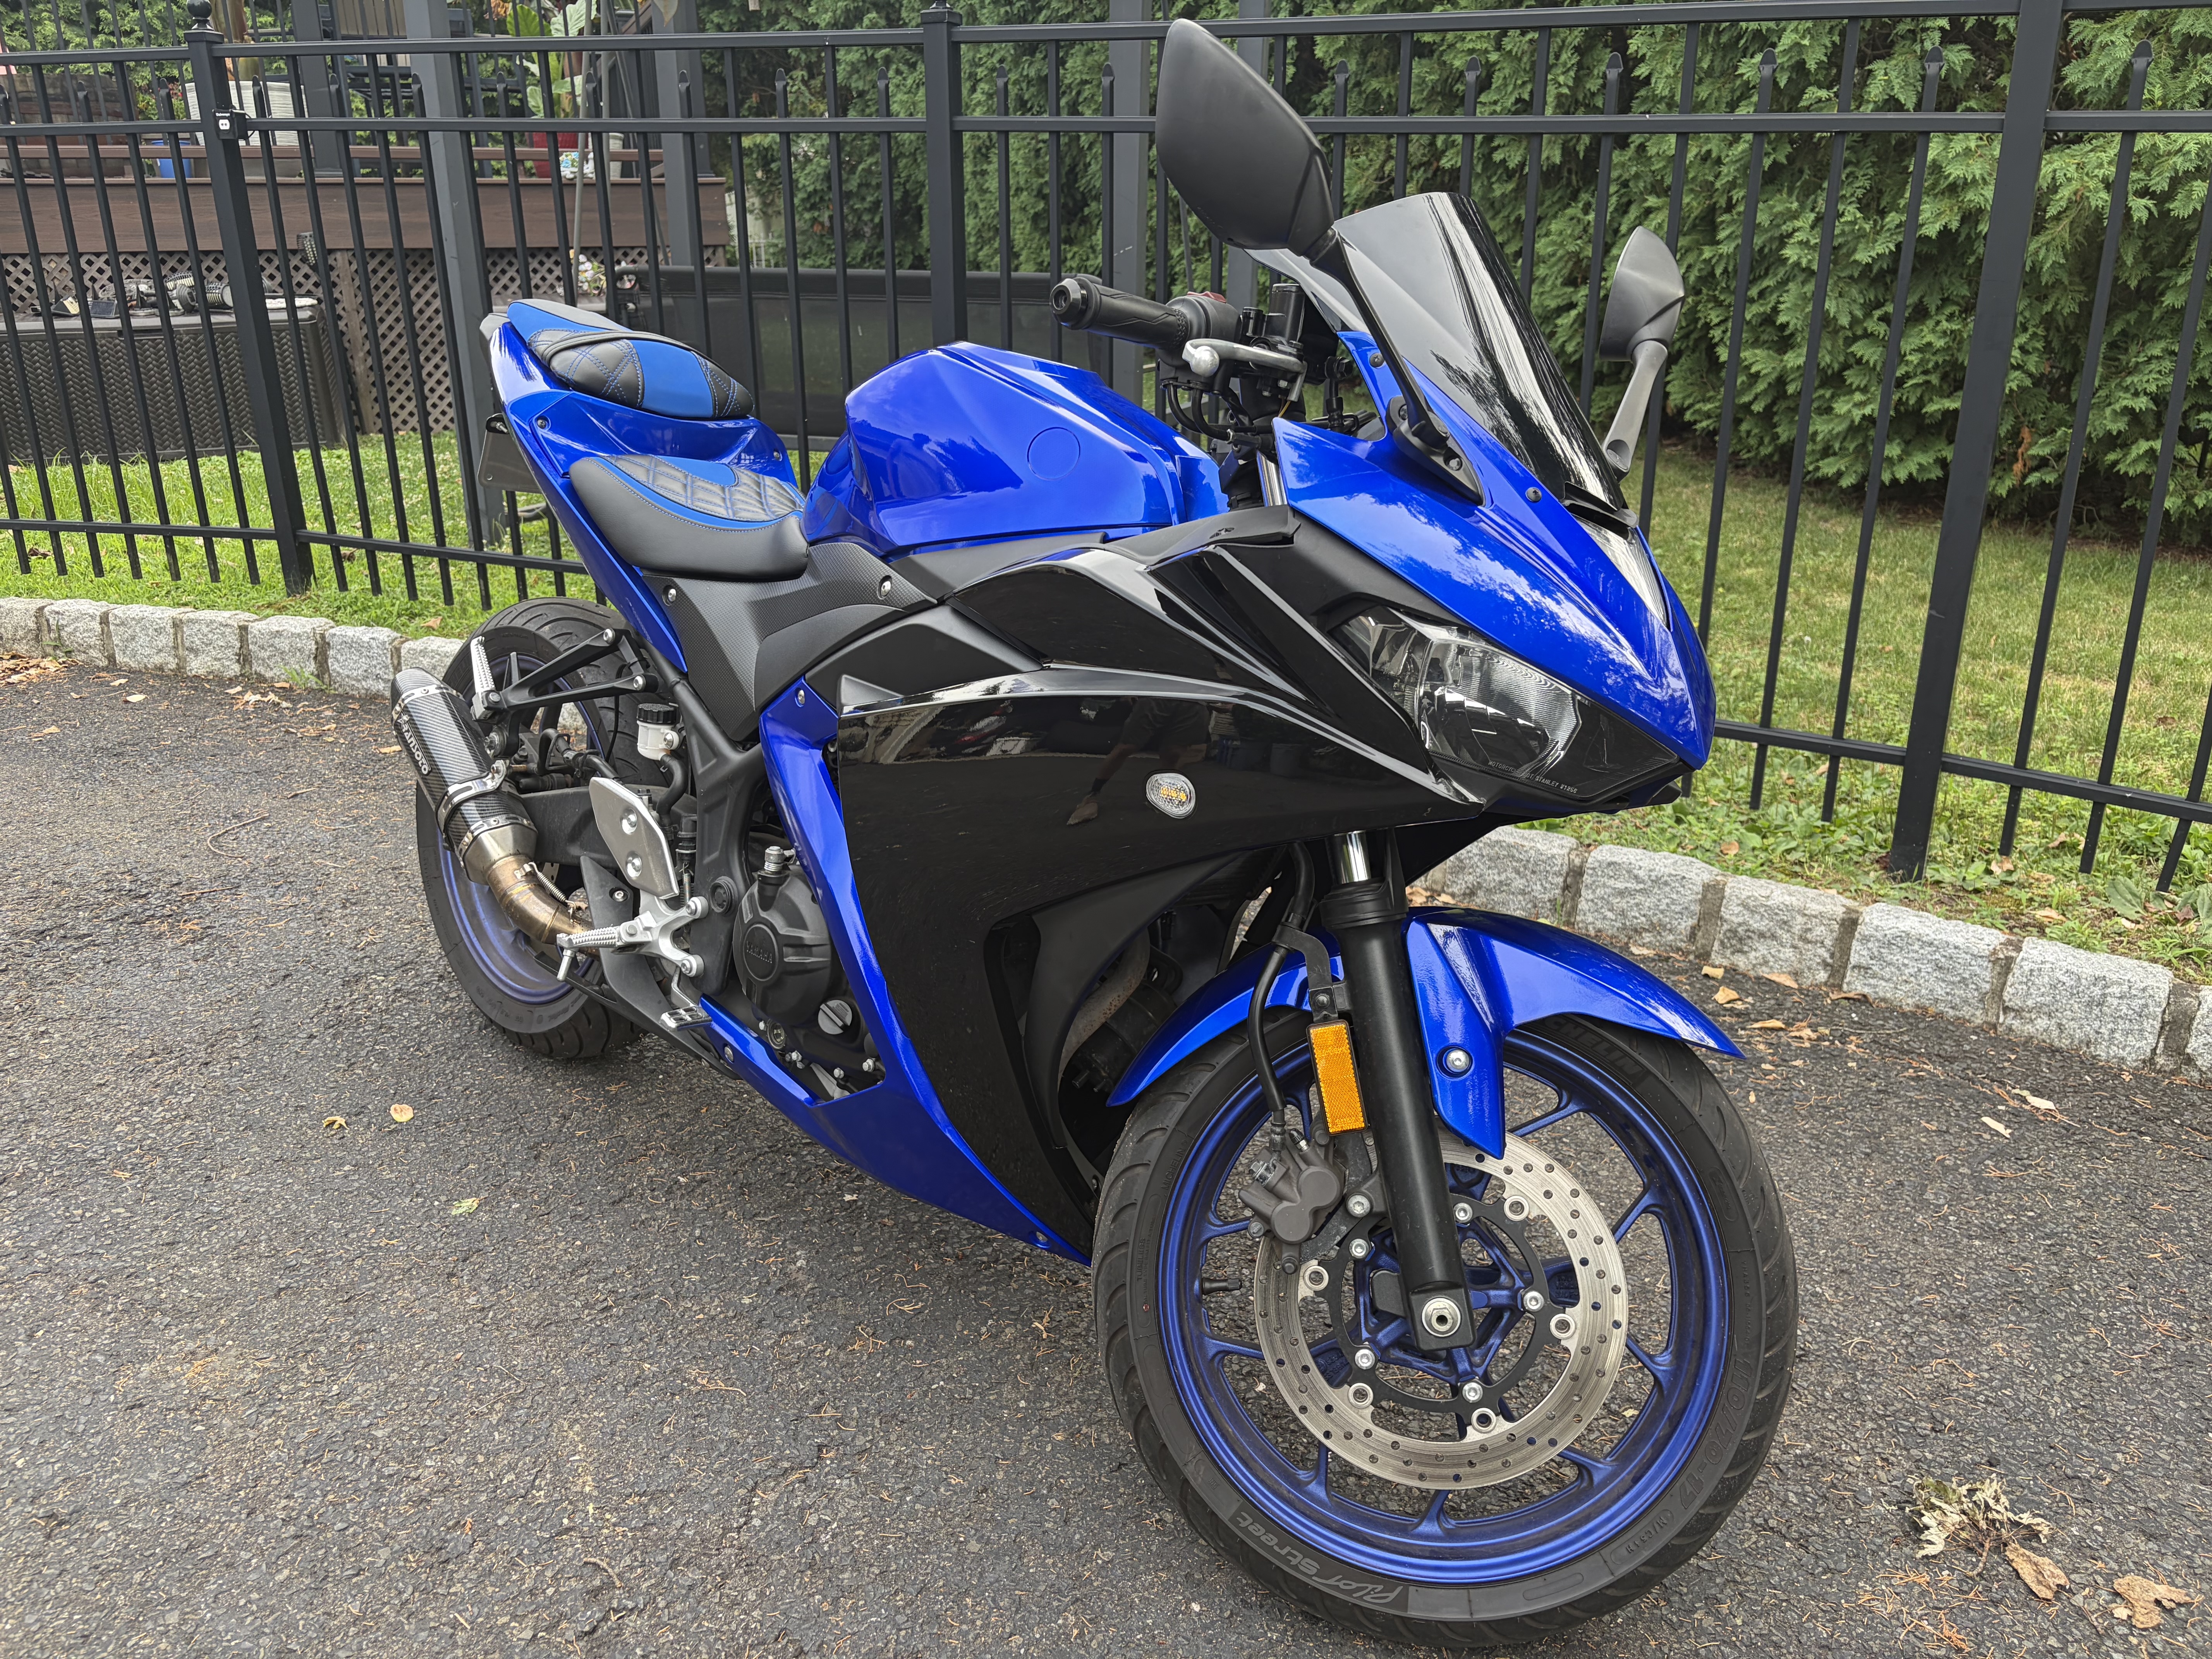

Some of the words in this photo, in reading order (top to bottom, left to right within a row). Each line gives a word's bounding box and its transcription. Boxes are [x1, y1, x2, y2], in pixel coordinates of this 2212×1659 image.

[1488, 760, 1520, 774] MOTORCYC
[1535, 775, 1559, 787] STANLEY
[747, 941, 773, 964] YAMAHA
[1545, 1017, 1643, 1075] CHELIN
[1161, 1147, 1185, 1190] MICHELIN
[1136, 1237, 1146, 1281] TUBELESS
[1680, 1358, 1752, 1510] 110/70-17
[1237, 1511, 1320, 1575] Street
[1312, 1575, 1403, 1604] Pilot
